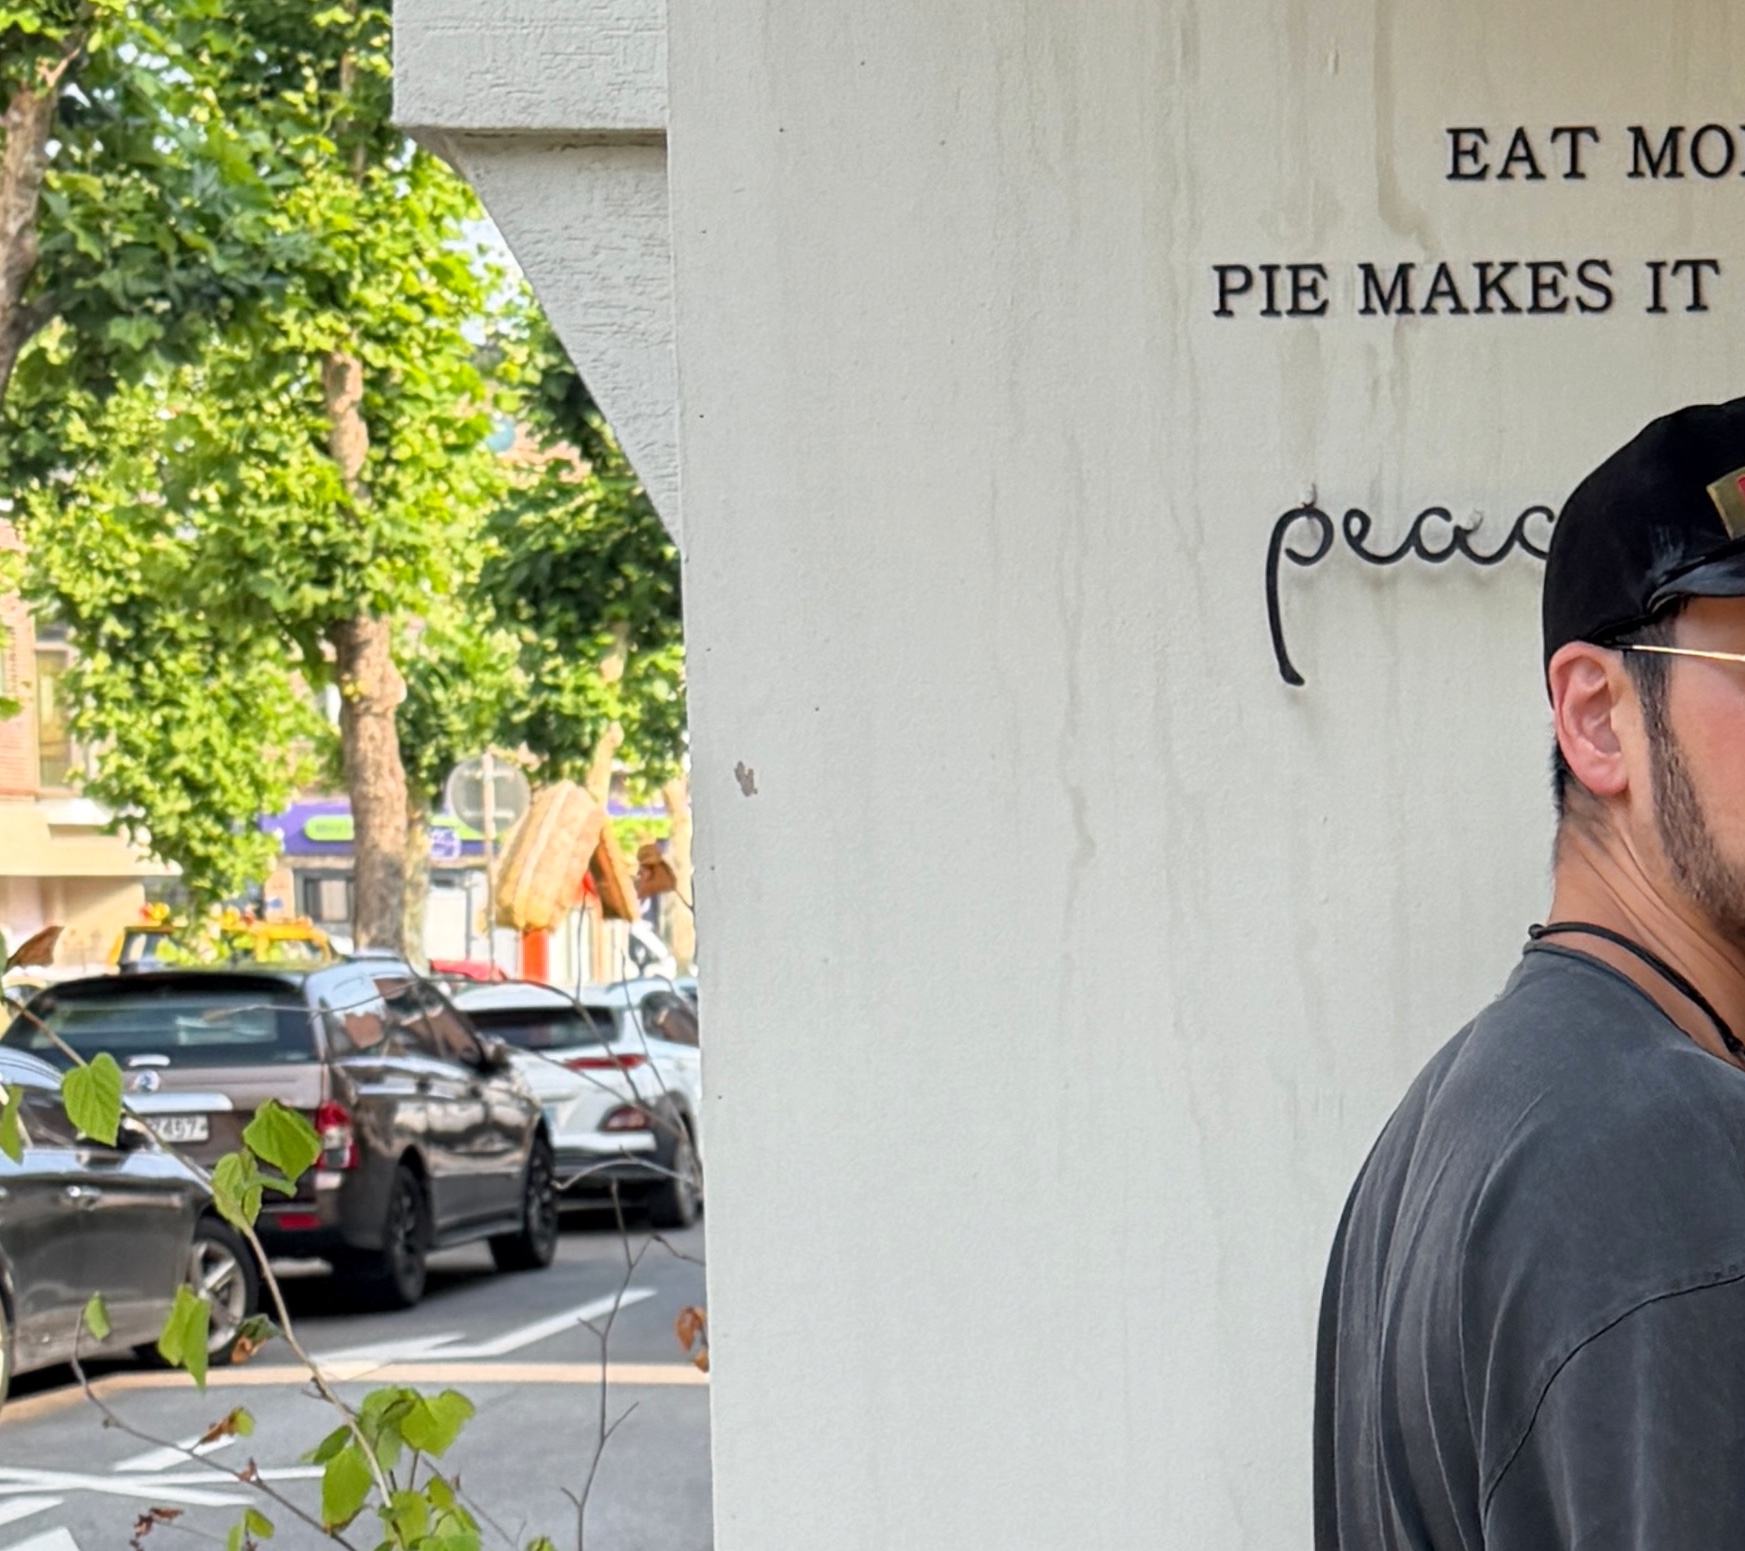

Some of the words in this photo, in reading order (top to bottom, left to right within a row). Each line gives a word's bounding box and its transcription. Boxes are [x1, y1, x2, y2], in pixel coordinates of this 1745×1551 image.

[1445, 126, 1600, 181] EAT
[1212, 263, 1330, 317] PIE
[1357, 259, 1613, 315] MAKES
[1645, 258, 1721, 313] IT
[1265, 507, 1555, 687] peac
